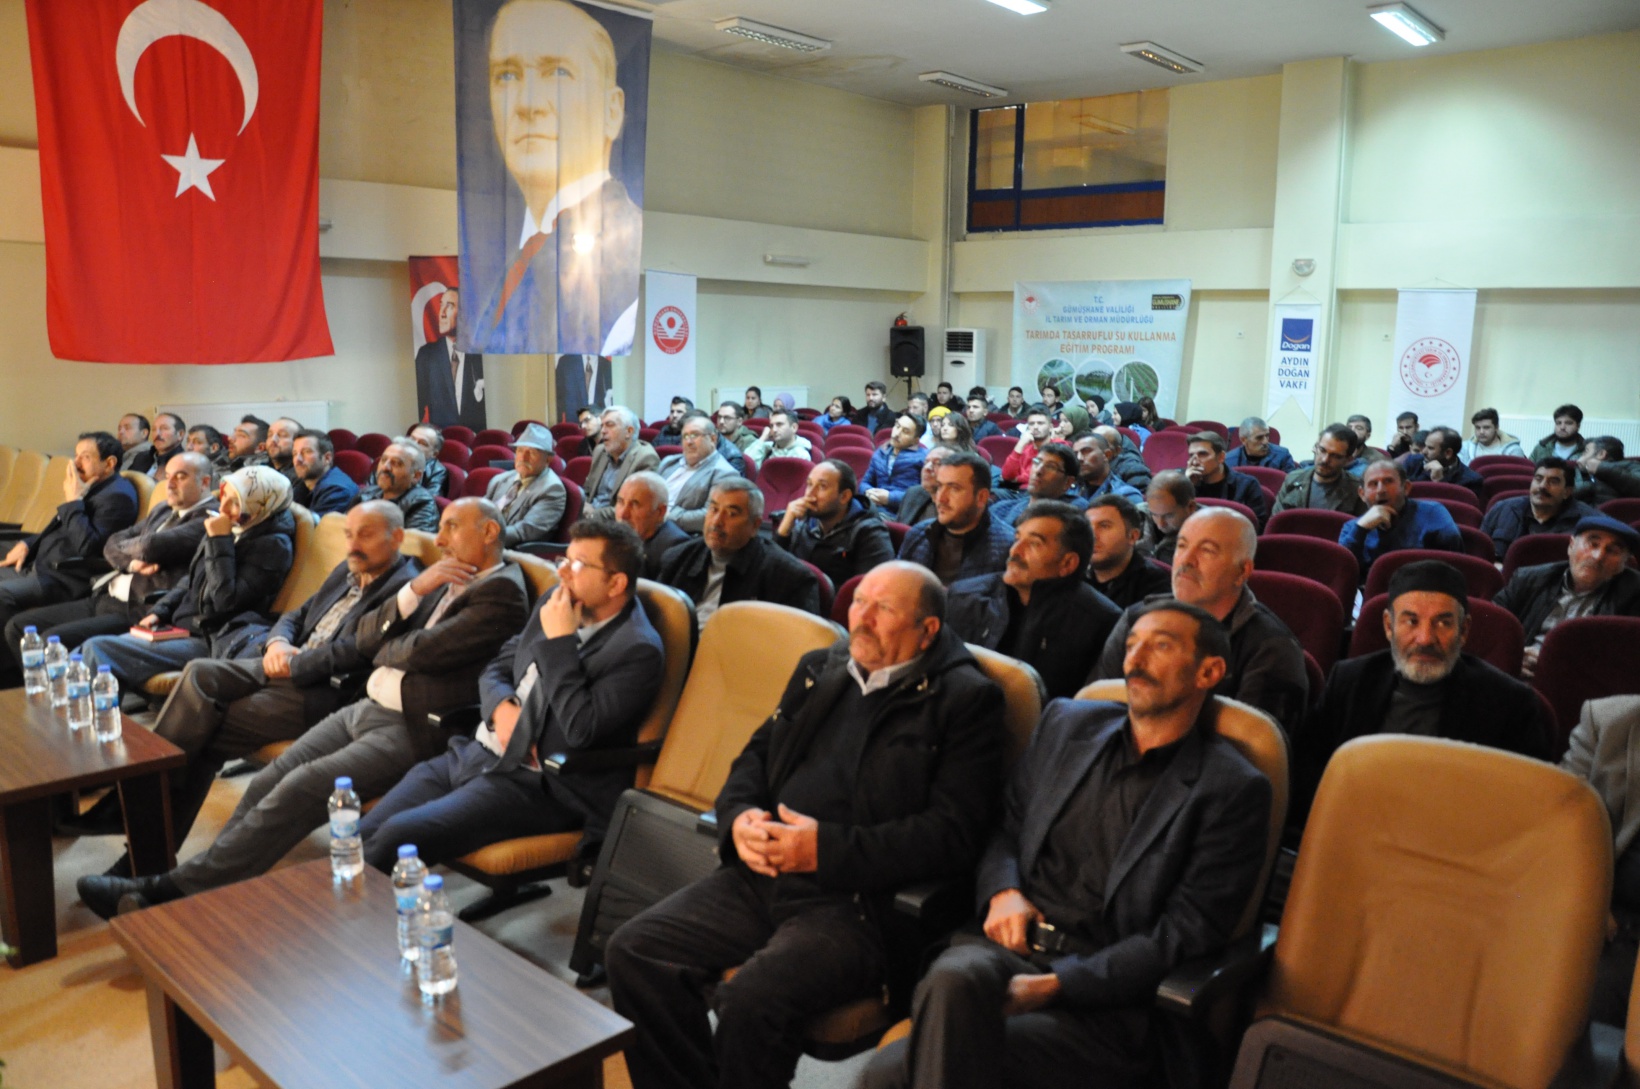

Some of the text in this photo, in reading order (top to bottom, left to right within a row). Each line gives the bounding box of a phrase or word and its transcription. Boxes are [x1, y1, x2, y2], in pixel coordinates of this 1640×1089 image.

[1062, 305, 1104, 314] GÜMÜŞHANE
[1110, 315, 1154, 324] MÜDÜRLÜĞÜ
[1025, 329, 1176, 341] TARIMDA TASARRUFLU SU KULLANMA
[1091, 344, 1135, 355] PROGRAMI
[1281, 357, 1309, 366] AYDIN
[1278, 367, 1309, 377] DOĞAN
[1280, 380, 1307, 389] VAKFI
